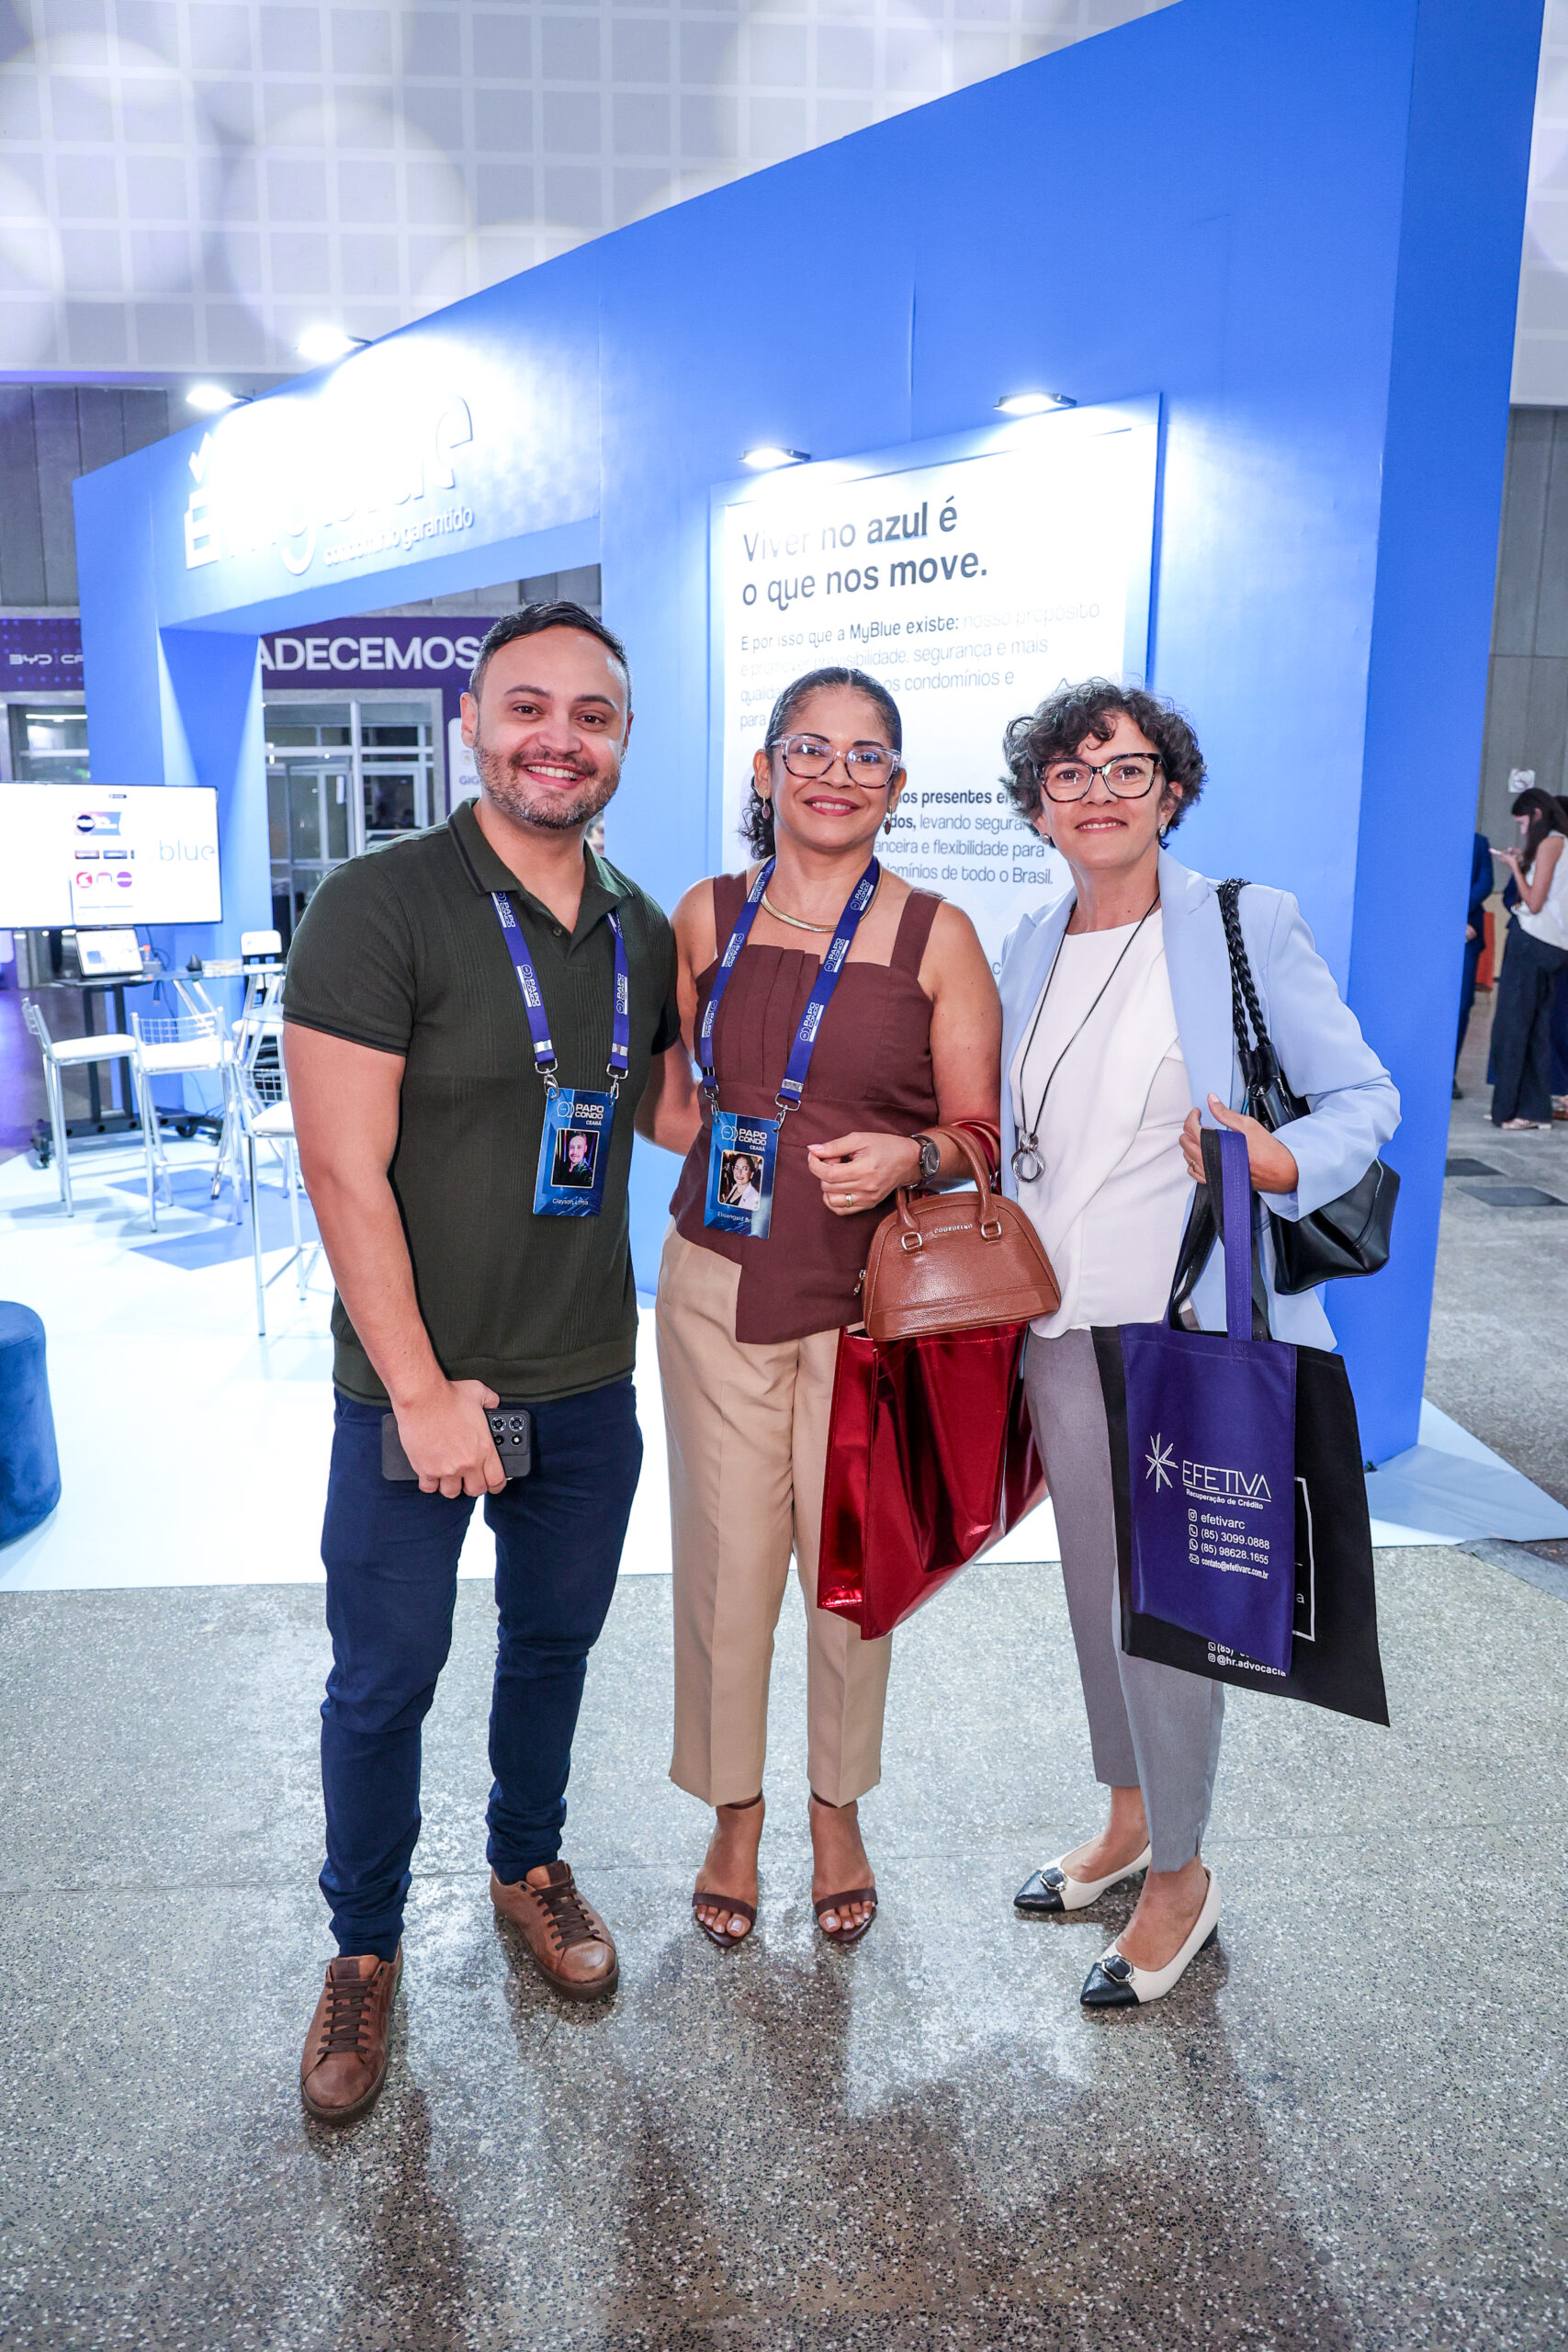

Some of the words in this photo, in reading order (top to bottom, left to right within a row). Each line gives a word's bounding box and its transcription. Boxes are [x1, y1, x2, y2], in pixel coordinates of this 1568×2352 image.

[400, 505, 474, 551] garantido
[742, 530, 810, 562] Viver
[821, 523, 856, 551] no
[867, 502, 928, 544] azul
[939, 495, 957, 533] é
[742, 583, 757, 606] o
[767, 574, 816, 611] que
[827, 565, 879, 595] nos
[889, 551, 987, 587] move.
[752, 636, 773, 653] por
[777, 632, 804, 647] isso
[808, 630, 832, 649] que
[838, 628, 845, 641] a
[850, 621, 901, 644] MyBlue
[906, 615, 959, 635] existe:
[964, 611, 1010, 629] nosso
[913, 641, 992, 666] segurança
[997, 641, 1007, 656] e
[1011, 637, 1049, 655] mais
[905, 669, 1000, 691] condomínios
[1005, 671, 1014, 685] e
[740, 713, 766, 731] para
[921, 789, 992, 808] presentes
[919, 814, 973, 831] levando
[921, 841, 930, 854] e
[933, 839, 1009, 856] flexibilidade
[1012, 844, 1045, 861] para
[942, 864, 958, 879] de
[962, 865, 996, 882] todo
[999, 869, 1009, 883] o
[1012, 866, 1054, 885] Brasil.
[855, 878, 867, 899] PAPO
[503, 901, 516, 928] PAPO
[828, 937, 841, 960] PAPO
[529, 978, 542, 1007] PAPO
[803, 1001, 816, 1027] PAPO
[574, 1111, 604, 1120] CONDO
[575, 1102, 604, 1114] PAPO
[739, 1128, 768, 1139] PAPO
[739, 1136, 767, 1146] CONDO
[1182, 1459, 1271, 1499] EFETIVA
[1186, 1488, 1225, 1504] Recuperação
[1226, 1498, 1236, 1506] de
[1237, 1498, 1264, 1510] Crédito
[1201, 1513, 1246, 1530] efetivarc
[1201, 1528, 1219, 1543] (85)
[1221, 1532, 1270, 1550] 3099.0888
[1201, 1543, 1217, 1556] (85)
[1219, 1545, 1269, 1565] 98628.1655
[1201, 1557, 1269, 1579] contato@efetivarc.com.br
[1216, 1655, 1287, 1678] @hr.advocacia
